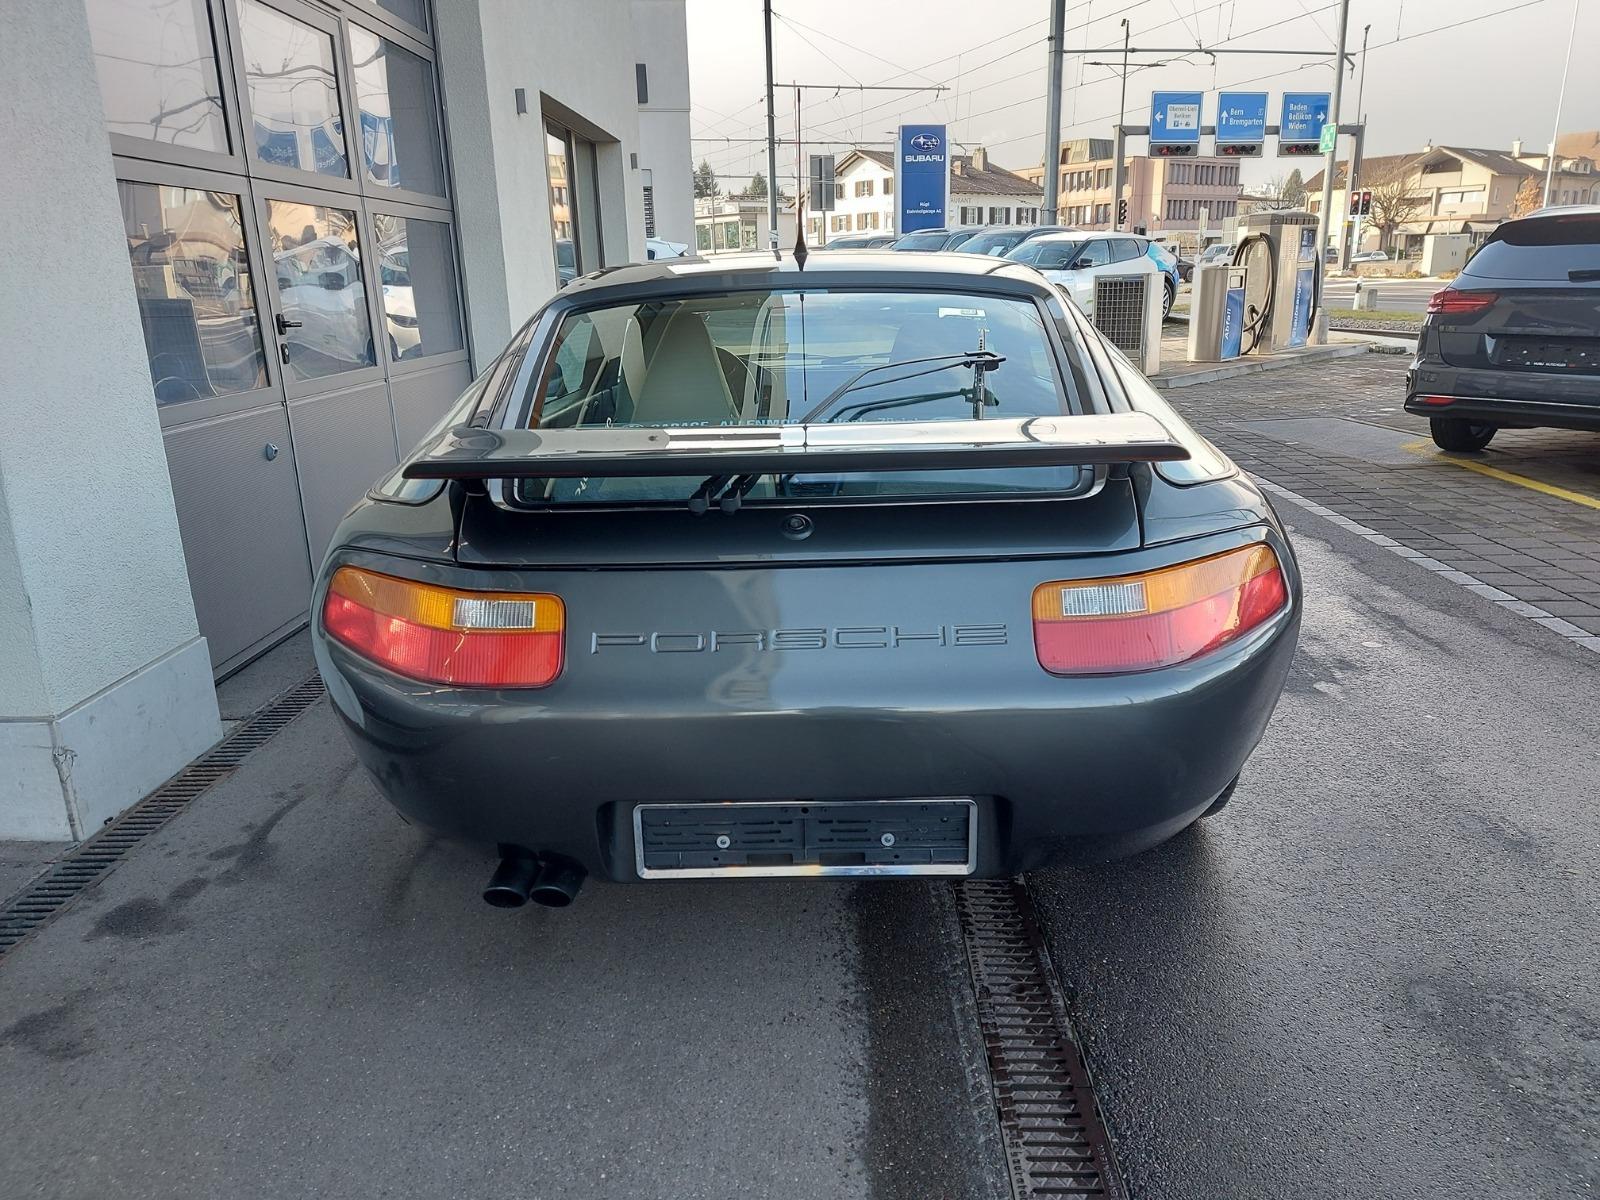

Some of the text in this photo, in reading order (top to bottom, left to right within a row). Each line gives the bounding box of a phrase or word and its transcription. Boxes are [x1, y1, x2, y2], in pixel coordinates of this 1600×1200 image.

[1230, 107, 1244, 115] Bern
[1289, 103, 1308, 111] Baden
[1288, 112, 1312, 120] Bellikon
[1229, 117, 1263, 127] Bremgarten
[1288, 121, 1307, 129] Widen
[905, 154, 944, 163] SUBARU
[1224, 307, 1232, 340] Abfall
[590, 622, 1008, 655] PORSCHE
